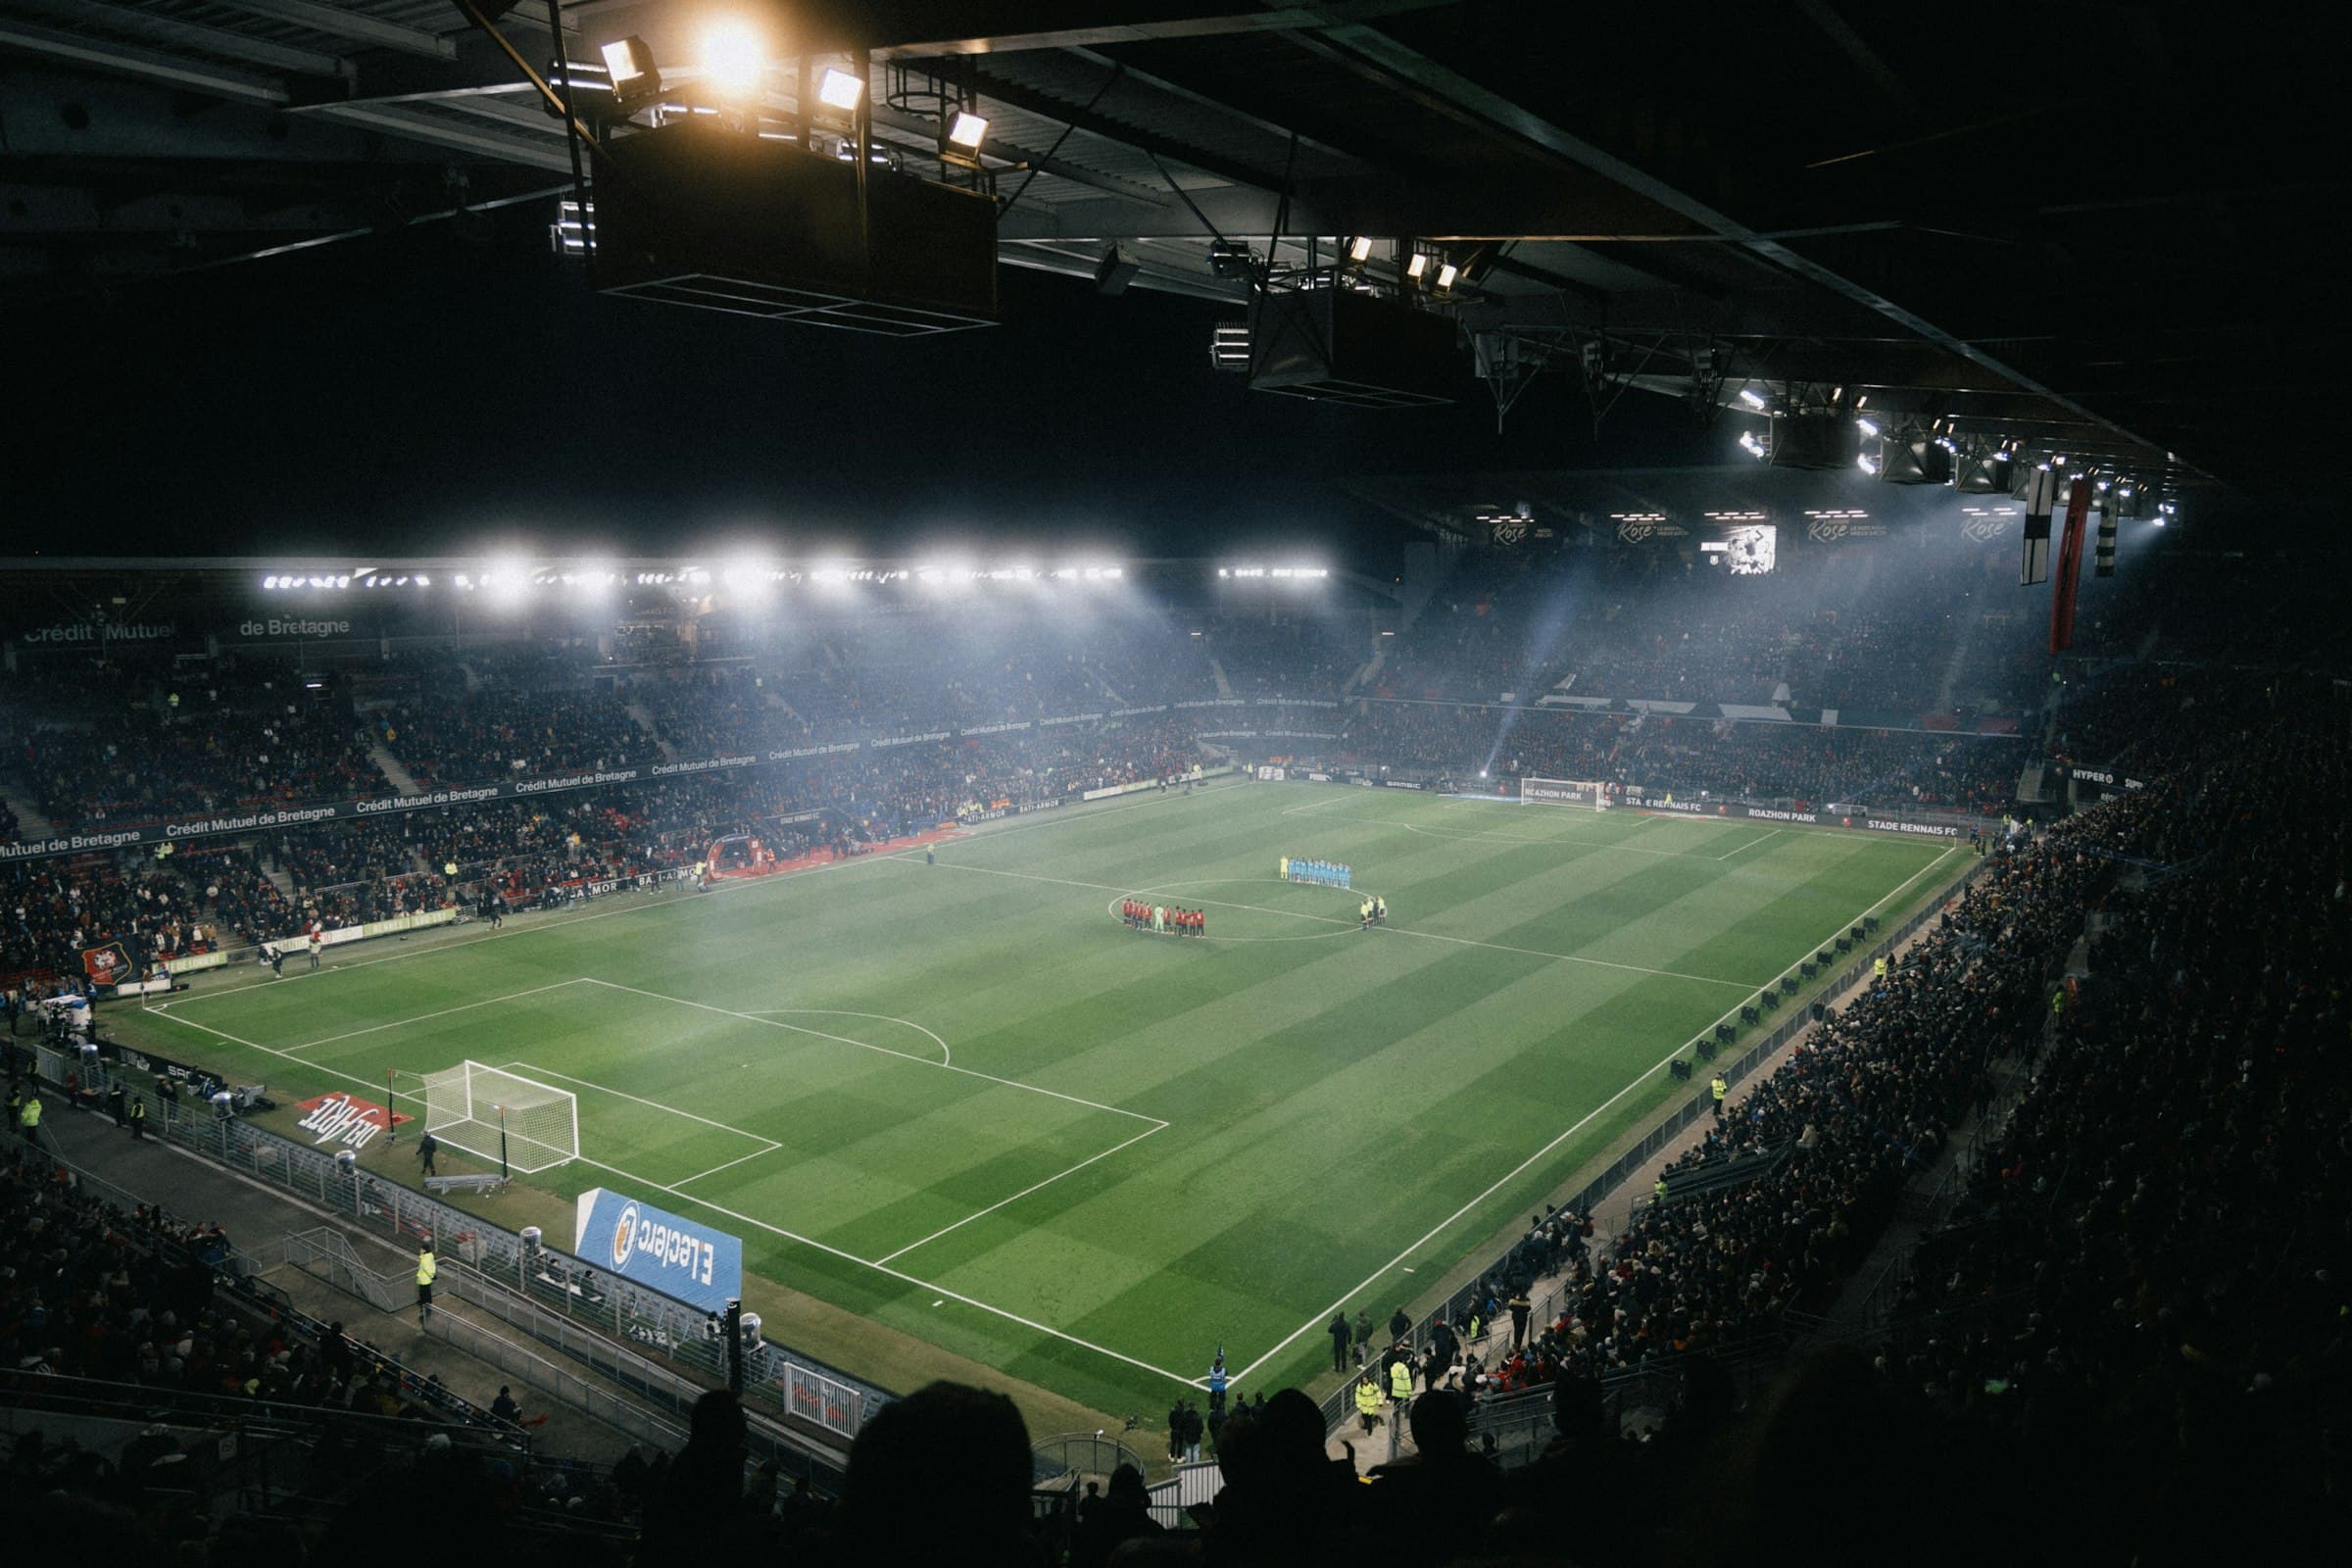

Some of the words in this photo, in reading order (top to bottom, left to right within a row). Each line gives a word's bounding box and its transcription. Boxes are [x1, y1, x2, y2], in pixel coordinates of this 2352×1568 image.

[1493, 524, 1527, 545] Rose
[1617, 521, 1653, 543] Rose
[1808, 519, 1850, 542] Rose
[1961, 517, 2008, 542] Rose
[240, 621, 264, 635] de
[269, 619, 350, 637] Bretagne
[769, 750, 792, 760] Crédit
[793, 747, 817, 758] Mutuel
[829, 742, 859, 753] Bretagne
[652, 764, 678, 775] Crédit
[679, 760, 707, 772] Mutuel
[709, 760, 719, 768] de
[721, 755, 756, 766] Bretagne
[516, 781, 546, 793] Crédit
[548, 776, 580, 789] Mutuel
[582, 775, 593, 785] de
[595, 770, 637, 784] Bretagne
[2073, 769, 2104, 783] HYPER
[356, 798, 392, 813] Crédit
[394, 794, 432, 808] Mutuel
[434, 793, 448, 804] de
[450, 787, 498, 801] Bretagne
[1525, 789, 1560, 799] ROAZHON
[1562, 791, 1581, 801] PARK
[1626, 797, 1651, 807] STAE
[1690, 803, 1701, 811] FC
[1020, 800, 1058, 813] BATI-ARMOR
[1749, 808, 1790, 820] ROAZHON
[1791, 812, 1815, 822] PARK
[167, 822, 208, 836] Crédit
[212, 815, 256, 831] Mutuel
[259, 814, 275, 825] de
[278, 807, 335, 823] Bretagne
[1868, 820, 1898, 831] STADE
[1901, 824, 1943, 835] RENNAIS
[1945, 827, 1958, 836] FC
[49, 840, 68, 851] de
[72, 832, 141, 849] Bretagne
